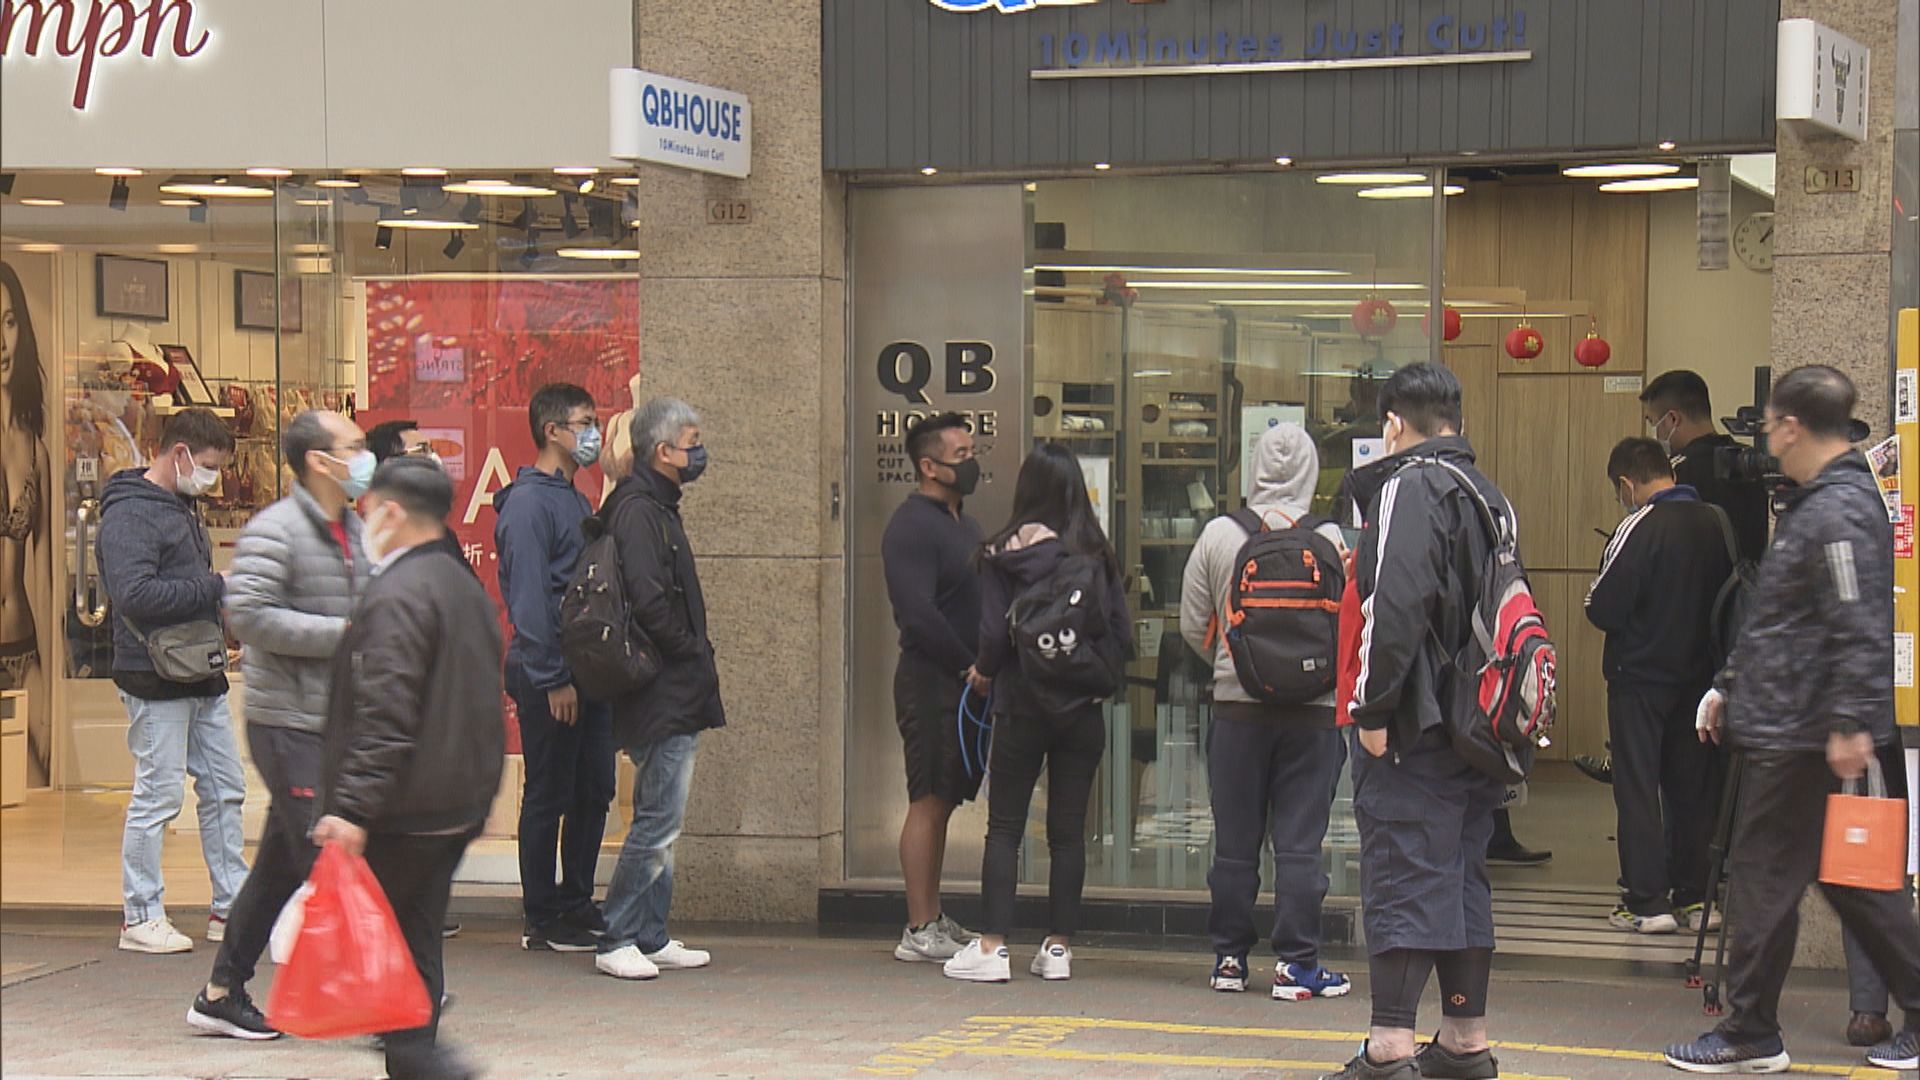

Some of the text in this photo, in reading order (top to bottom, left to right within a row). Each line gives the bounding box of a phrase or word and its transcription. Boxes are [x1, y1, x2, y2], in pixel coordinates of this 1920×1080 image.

[1040, 11, 1526, 65] 10Minutes Just Cut!
[642, 84, 741, 142] QBHOUSE
[1812, 169, 1854, 188] G13
[711, 203, 747, 220] G12
[877, 410, 997, 437] HOSE
[877, 443, 906, 455] HAI
[877, 458, 904, 469] CUT
